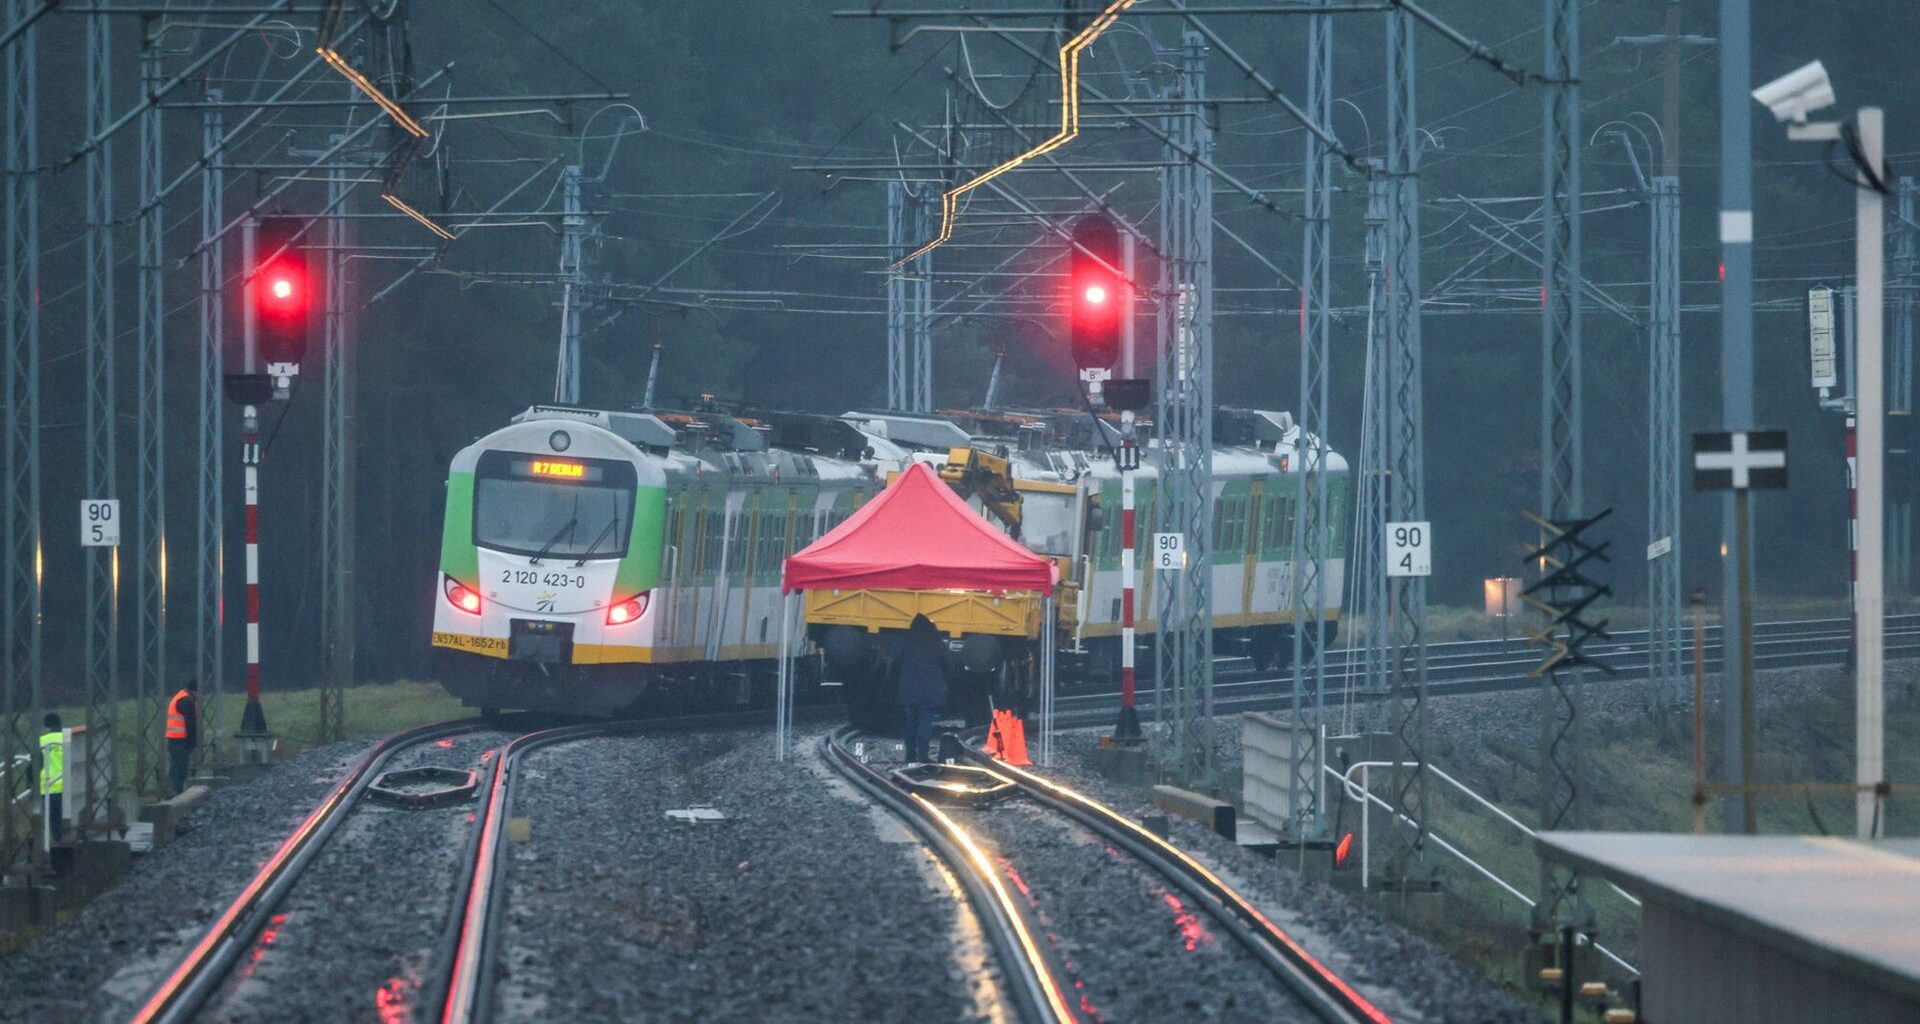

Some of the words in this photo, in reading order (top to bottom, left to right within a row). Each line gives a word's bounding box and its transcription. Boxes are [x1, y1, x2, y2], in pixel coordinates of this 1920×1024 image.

[279, 364, 287, 375] A
[88, 503, 112, 521] 90
[92, 524, 103, 542] 5
[1395, 527, 1422, 547] 90
[1160, 535, 1177, 550] 90
[1162, 552, 1171, 567] 6
[1400, 552, 1411, 573] 4
[502, 570, 511, 583] 2
[515, 571, 538, 585] 120
[543, 573, 585, 588] 423-0
